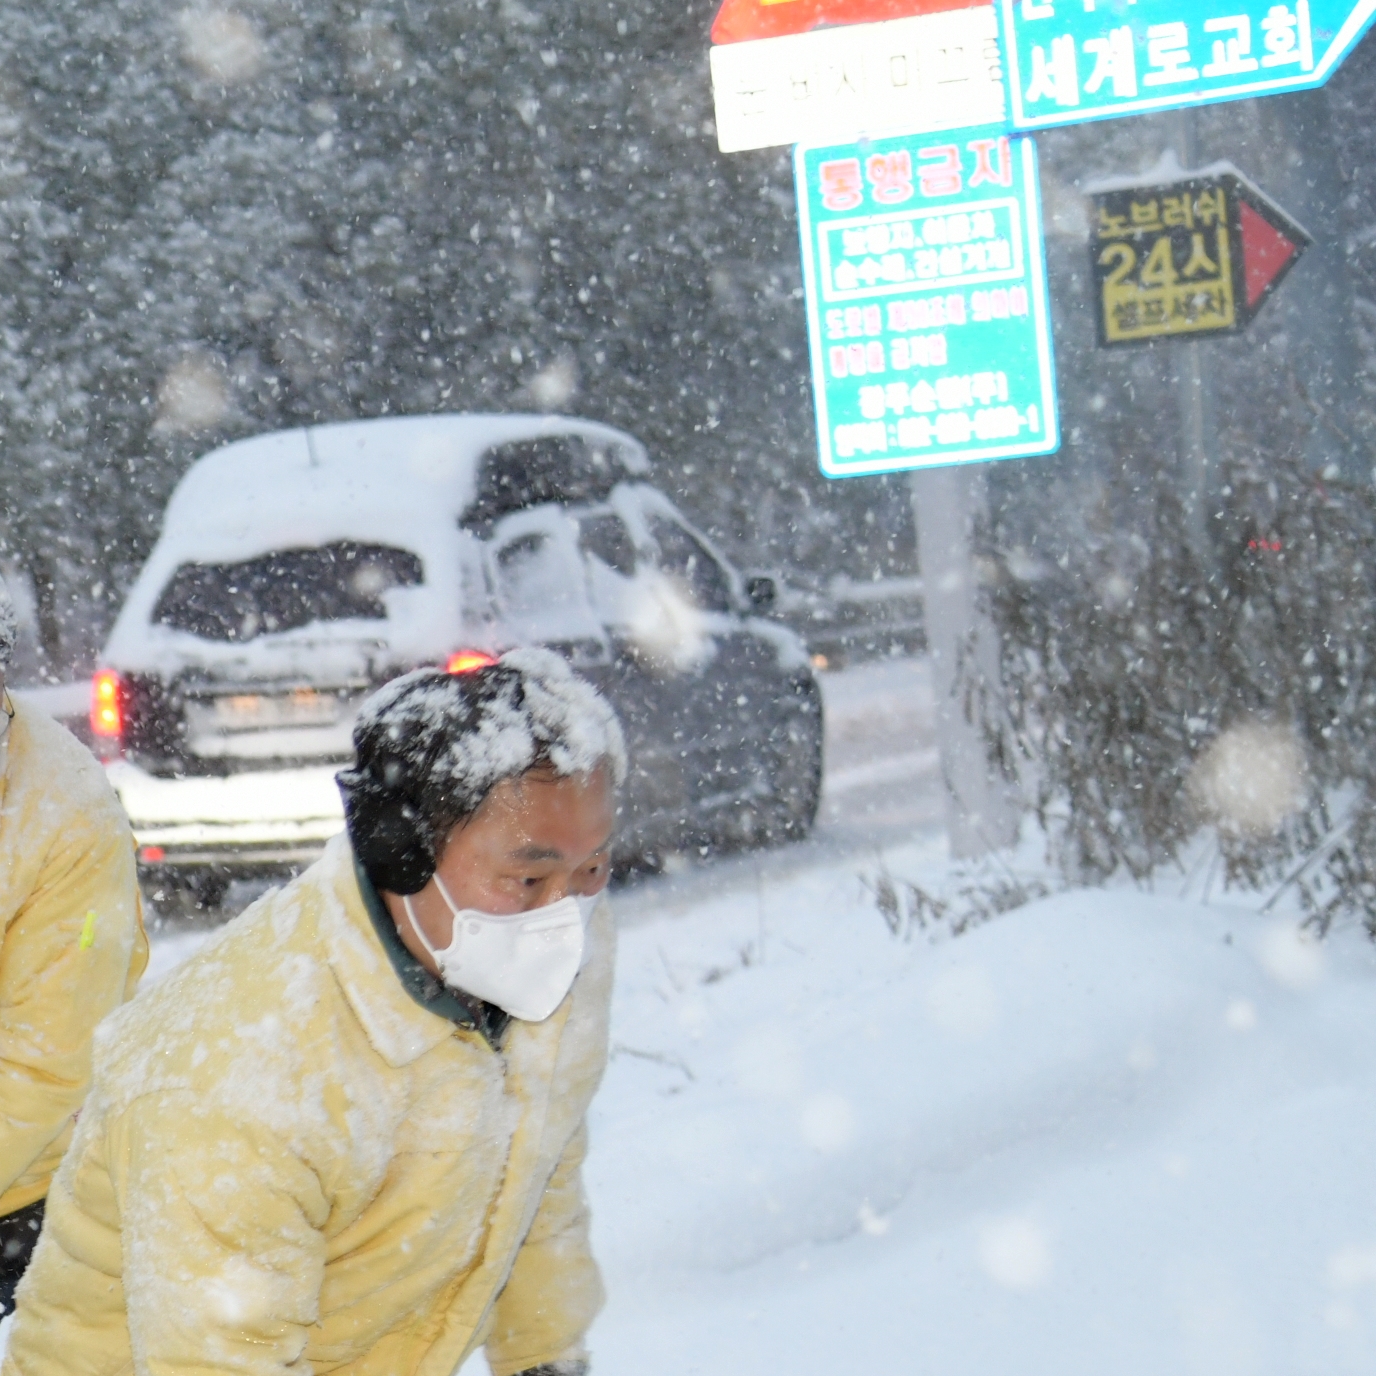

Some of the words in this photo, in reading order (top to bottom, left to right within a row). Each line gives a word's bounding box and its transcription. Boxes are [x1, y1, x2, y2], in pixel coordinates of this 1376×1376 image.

[1025, 2, 1313, 106] 세계로교회
[820, 138, 1012, 210] 통행금지
[1098, 187, 1227, 239] 노브러쉬
[1097, 227, 1230, 290] 24시
